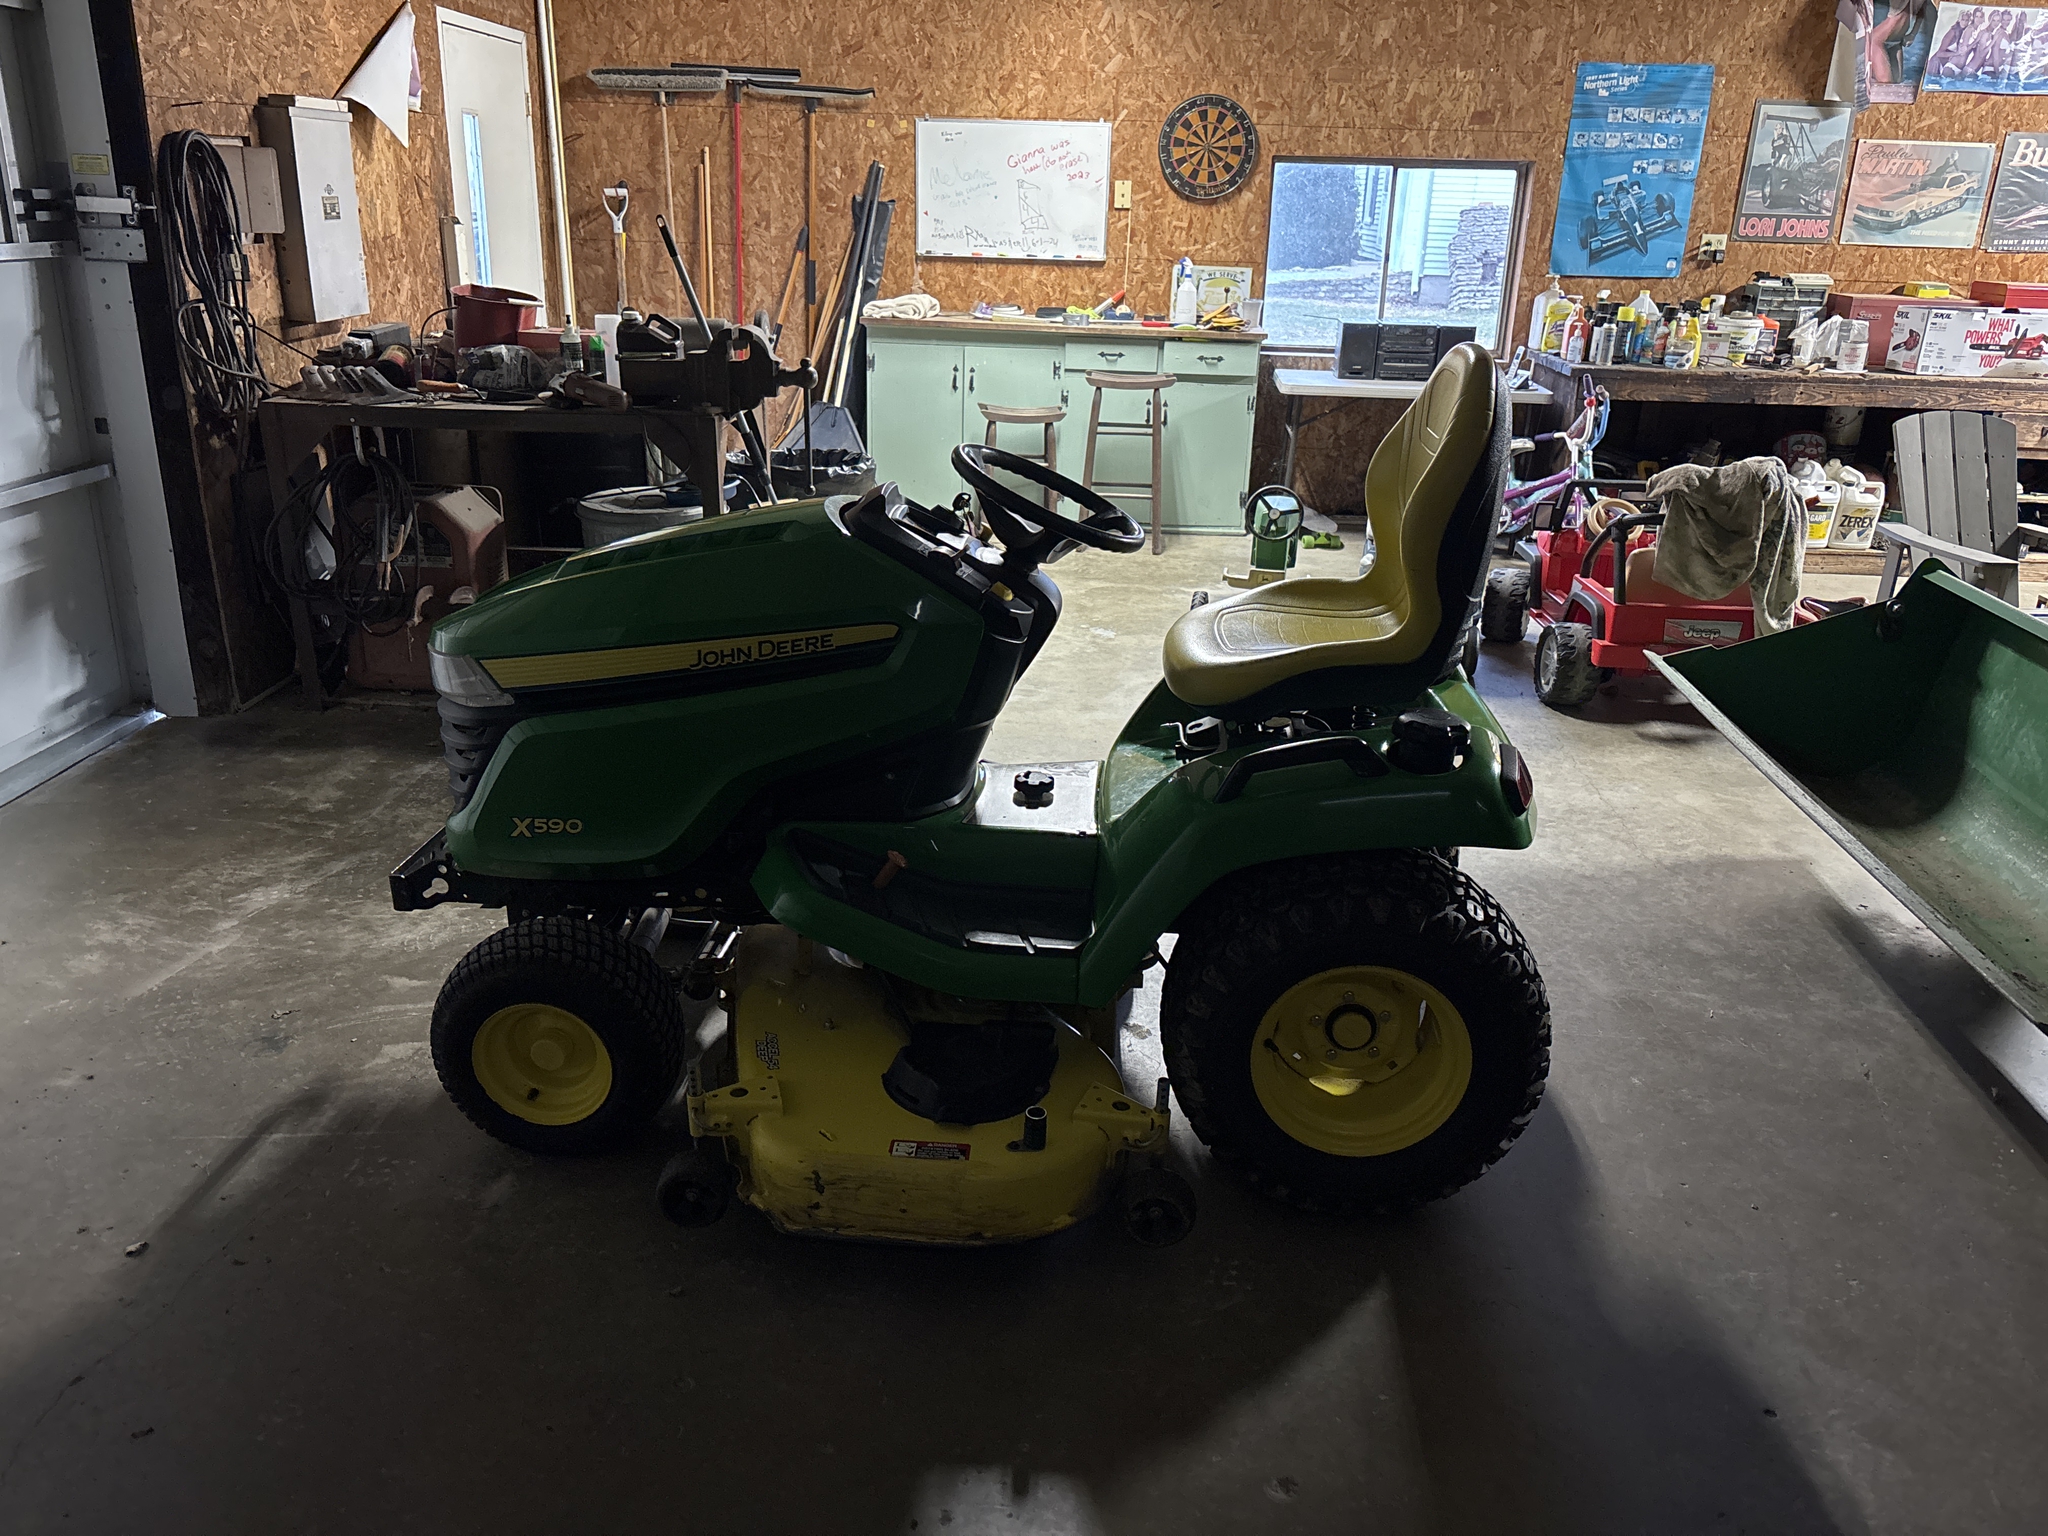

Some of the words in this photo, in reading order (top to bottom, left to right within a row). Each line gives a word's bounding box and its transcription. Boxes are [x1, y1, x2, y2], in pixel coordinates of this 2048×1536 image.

[1583, 78, 1617, 90] Northern
[1619, 75, 1639, 86] Light
[1007, 146, 1046, 169] Gianna
[1050, 139, 1071, 152] was
[1861, 144, 1914, 160] Paula
[1857, 158, 1932, 177] MARTIN
[1066, 170, 1091, 182] 2023
[1738, 217, 1777, 237] LORI
[1776, 217, 1831, 239] JOHNS
[1896, 311, 1910, 320] SKIL
[1932, 312, 1953, 320] SKIL
[1988, 317, 2017, 333] WHAT
[1964, 329, 2003, 344] POWERS
[1978, 354, 2003, 369] YOU?
[1839, 514, 1876, 528] ZEREX
[1683, 625, 1721, 640] Jeep
[689, 645, 752, 670] JOHN
[757, 633, 836, 660] DEERE
[510, 817, 583, 838] X590
[755, 1040, 768, 1062] DEEP
